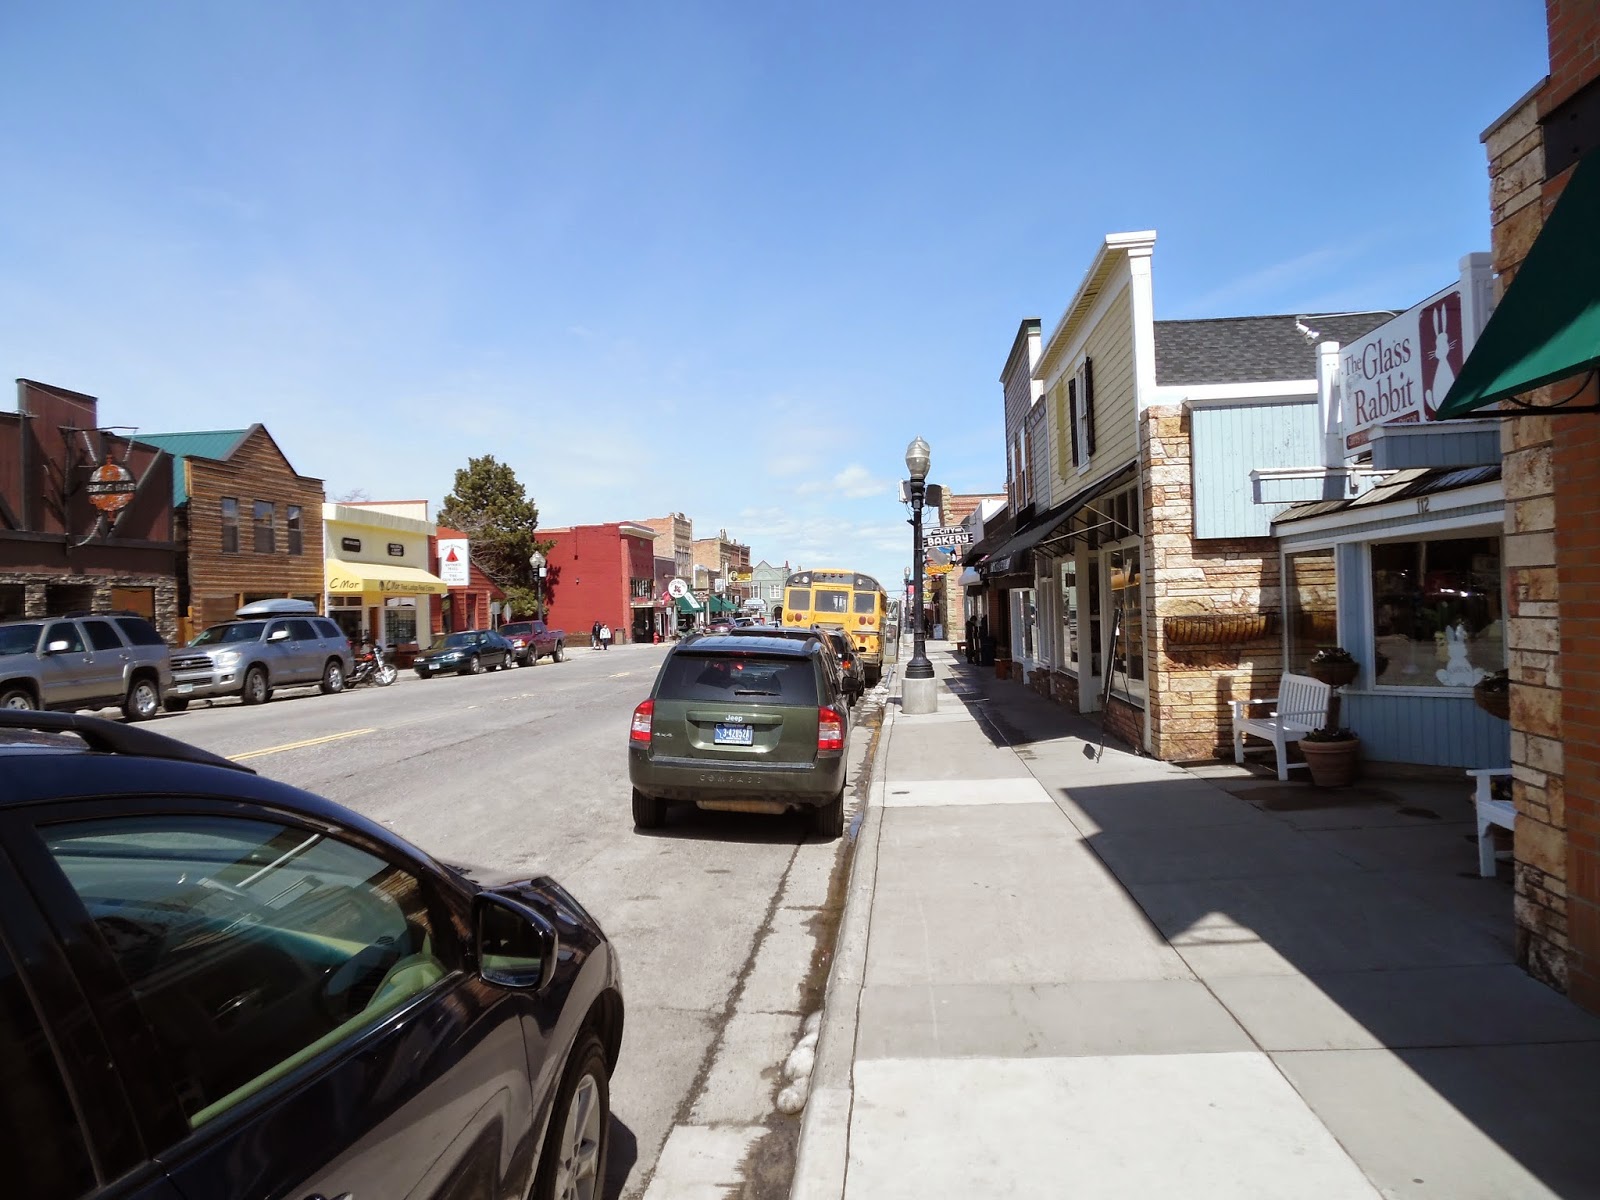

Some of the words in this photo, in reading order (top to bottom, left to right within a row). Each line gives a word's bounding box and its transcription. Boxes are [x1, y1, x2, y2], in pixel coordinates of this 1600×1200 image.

[1344, 354, 1362, 376] The
[1362, 337, 1411, 380] Glass
[1354, 371, 1415, 426] Rabbit
[1416, 496, 1430, 514] 112
[940, 527, 955, 535] CITY
[927, 534, 969, 547] BAKERY
[329, 577, 339, 589] C
[339, 580, 360, 589] Mor
